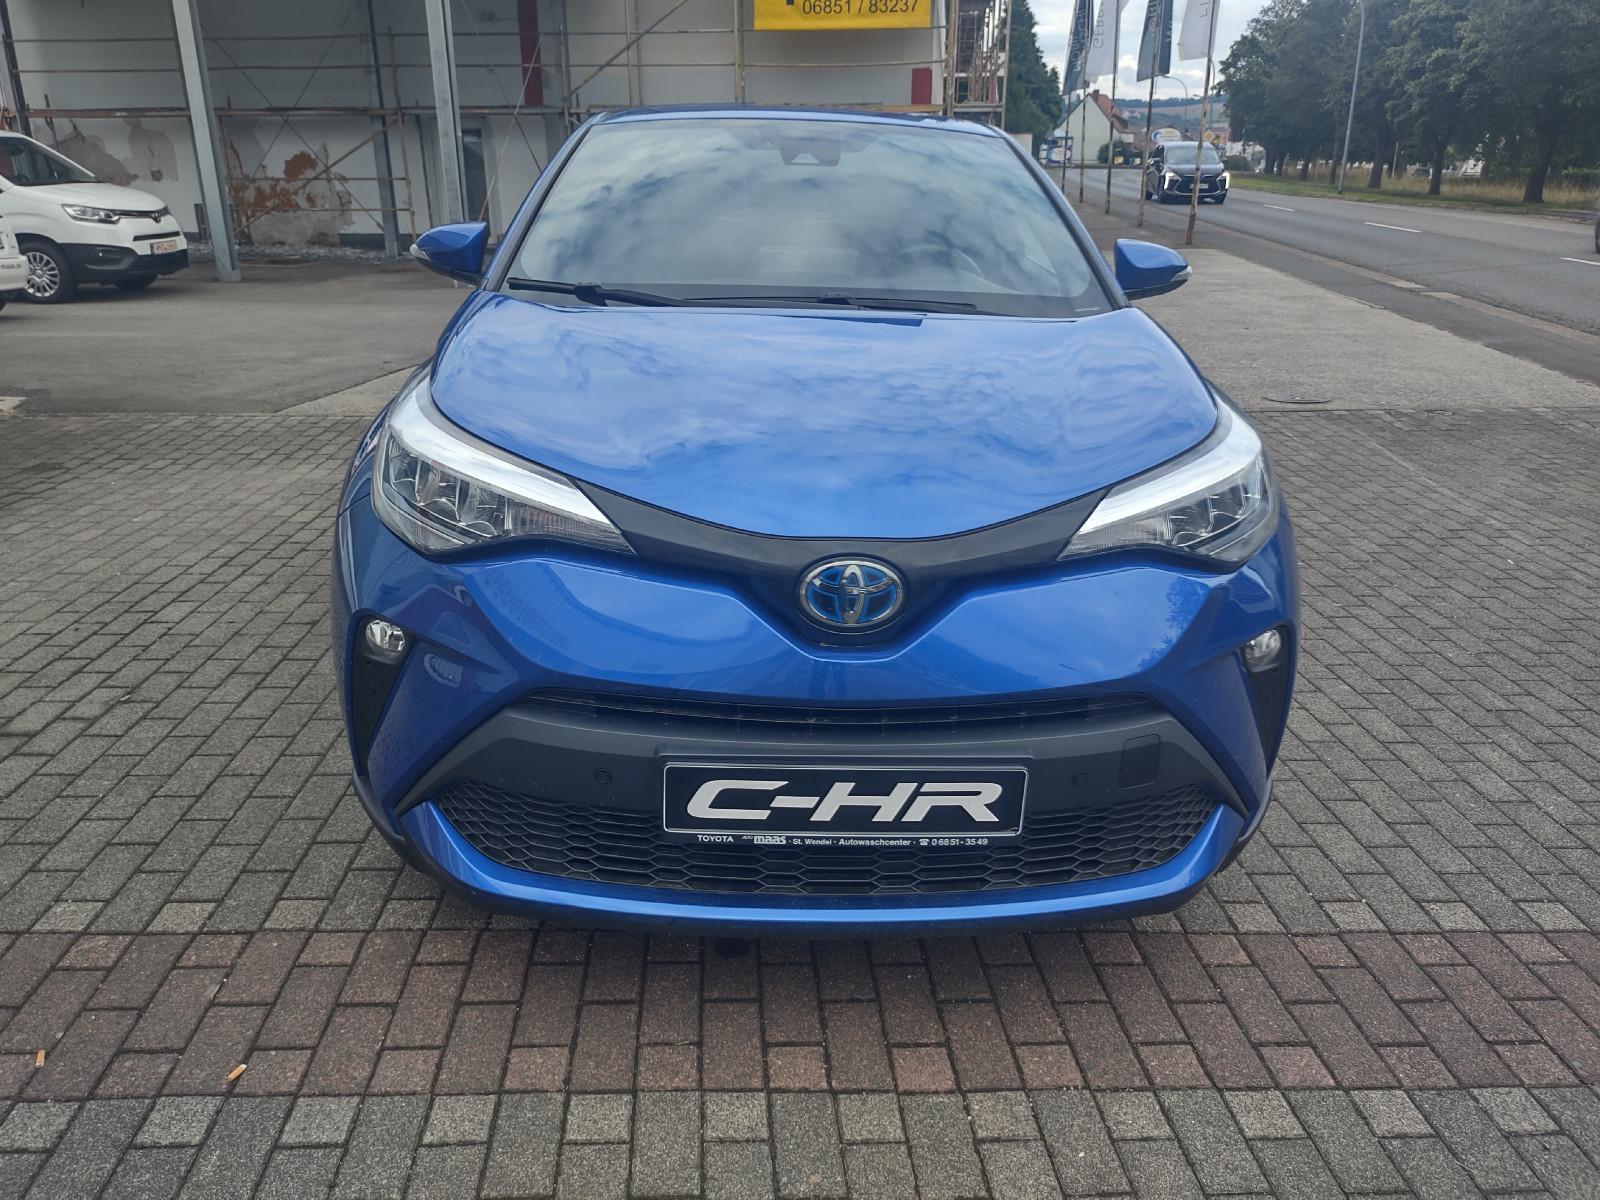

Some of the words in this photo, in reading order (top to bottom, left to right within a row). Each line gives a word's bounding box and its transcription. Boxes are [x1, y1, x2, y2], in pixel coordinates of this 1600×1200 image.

[802, 0, 851, 15] 06851
[868, 0, 918, 14] 83237
[686, 779, 1003, 822] C-HR
[697, 834, 734, 843] TOYOTA
[753, 835, 787, 845] maas
[804, 838, 832, 846] Wendel
[838, 838, 911, 846] Autowaschcenter
